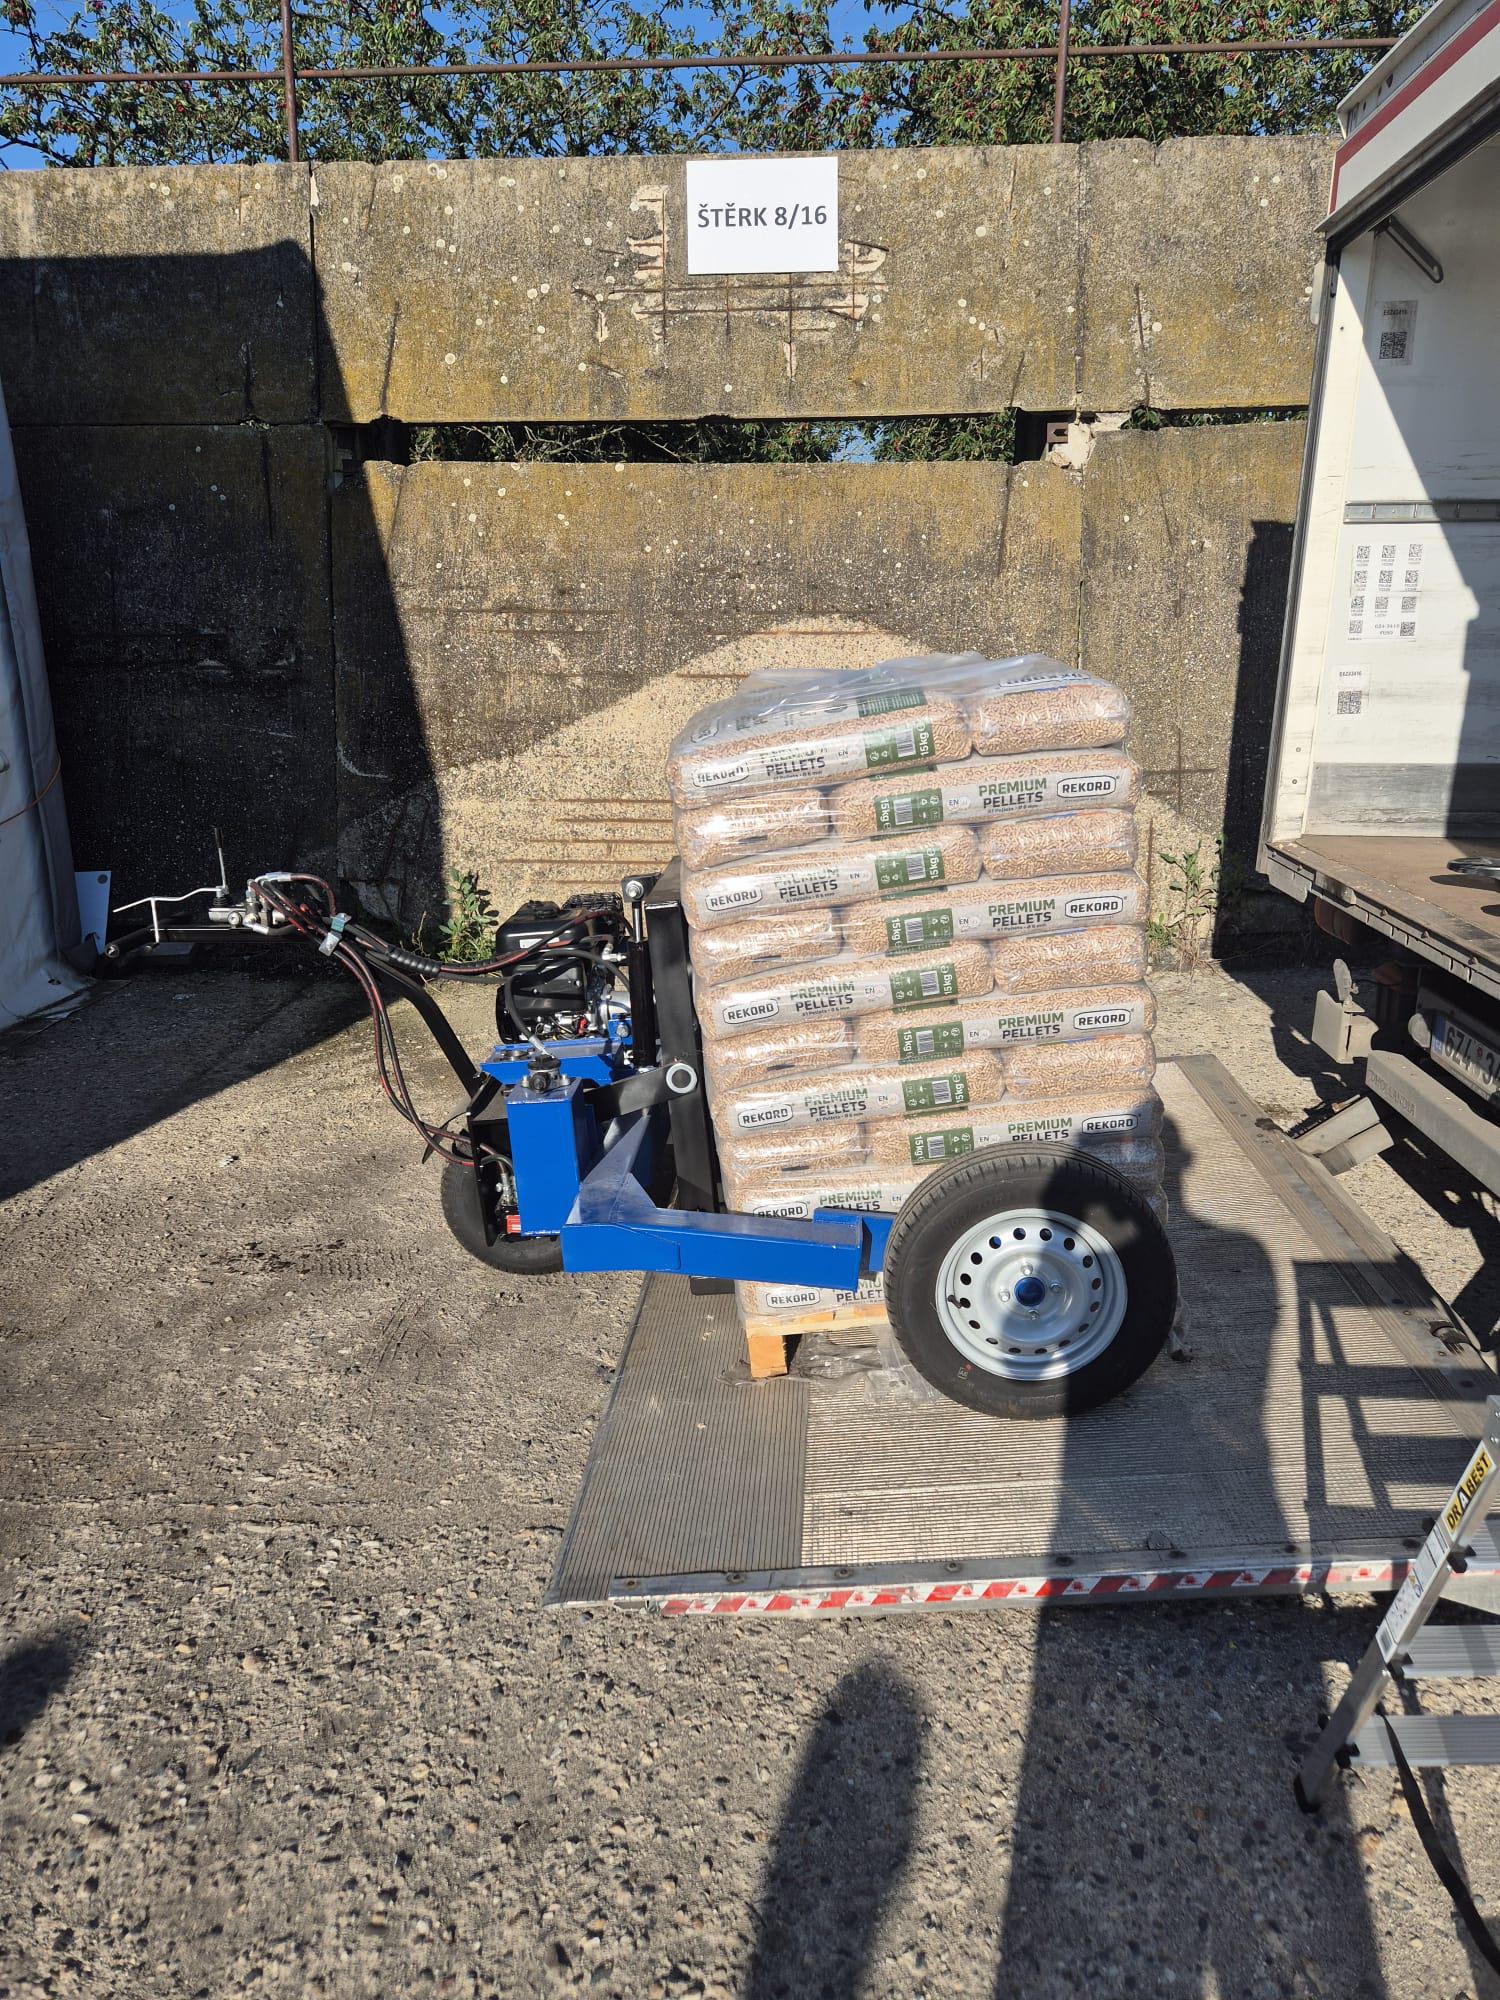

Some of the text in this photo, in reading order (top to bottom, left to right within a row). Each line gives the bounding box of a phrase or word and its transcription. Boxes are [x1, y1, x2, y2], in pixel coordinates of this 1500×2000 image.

[698, 202, 828, 230] ŠTĚRK 8/16
[919, 731, 930, 756] 15kg
[766, 756, 826, 776] PELLETS
[978, 778, 1047, 797] PREMIUM
[1062, 780, 1111, 794] REKORD
[983, 792, 1043, 808] PELLETS
[929, 857, 939, 879] 15kg
[779, 879, 838, 899] PELLETS
[988, 899, 1056, 916] PREMIUM
[1070, 901, 1118, 914] REKORD
[992, 911, 1052, 928] PELLETS
[891, 918, 902, 940] 15kg
[790, 981, 855, 1000] PREMIUM
[943, 974, 953, 995] 15kg
[796, 993, 854, 1012] PELLETS
[727, 1003, 774, 1020] REKORD
[1078, 1013, 1126, 1026] REKORD
[998, 1012, 1064, 1029] PREMIUM
[1002, 1024, 1061, 1040] PELLETS
[903, 1030, 913, 1052] 15kg
[804, 1088, 869, 1106] PREMIUM
[955, 1083, 965, 1103] 15kg
[742, 1108, 788, 1124] REKORD
[809, 1101, 867, 1118] PELLETS
[1008, 1117, 1073, 1134] PREMIUM
[1086, 1118, 1133, 1131] REKORD
[914, 1135, 925, 1156] 15kg
[819, 1189, 882, 1206] PREMIUM
[770, 1292, 816, 1305] REKORD
[836, 1289, 883, 1302] PELLET
